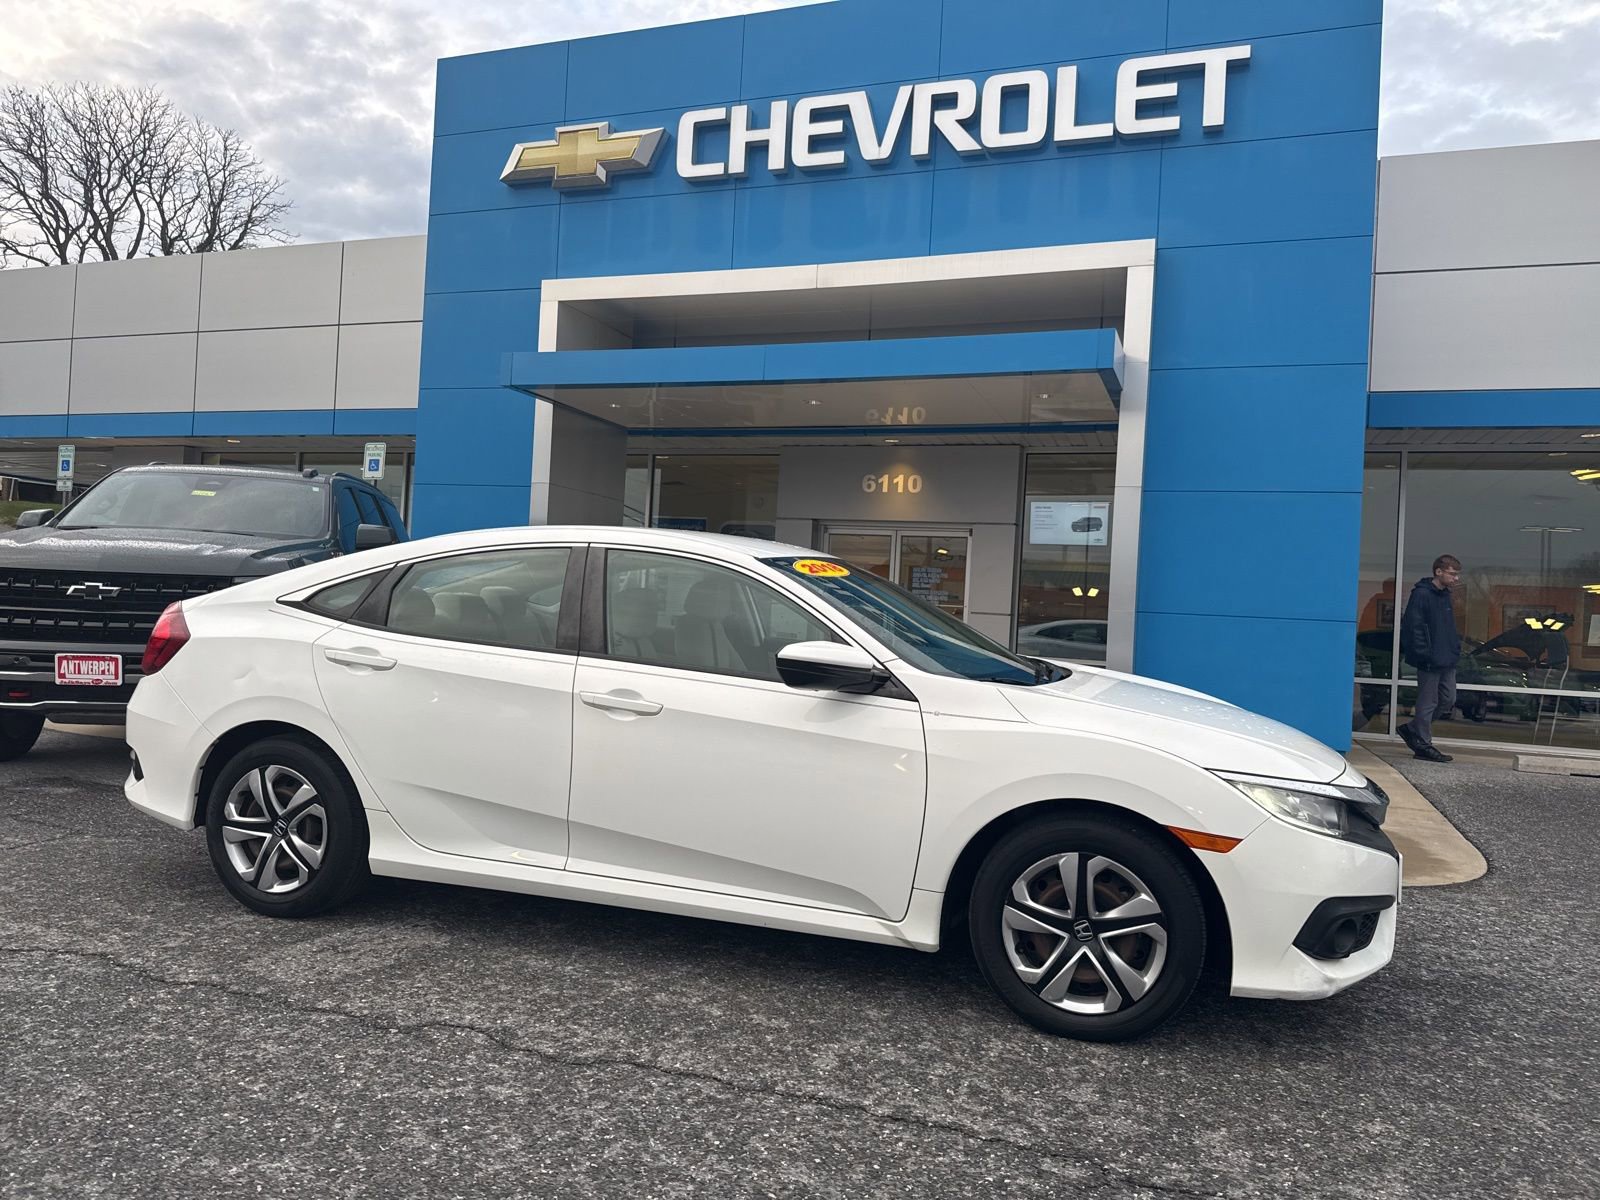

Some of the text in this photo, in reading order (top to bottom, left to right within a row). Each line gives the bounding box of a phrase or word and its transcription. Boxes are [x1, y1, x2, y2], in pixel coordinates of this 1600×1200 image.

[676, 44, 1252, 180] CHEVROLET
[862, 474, 922, 493] 6110
[60, 660, 115, 675] ANTWERPEN
